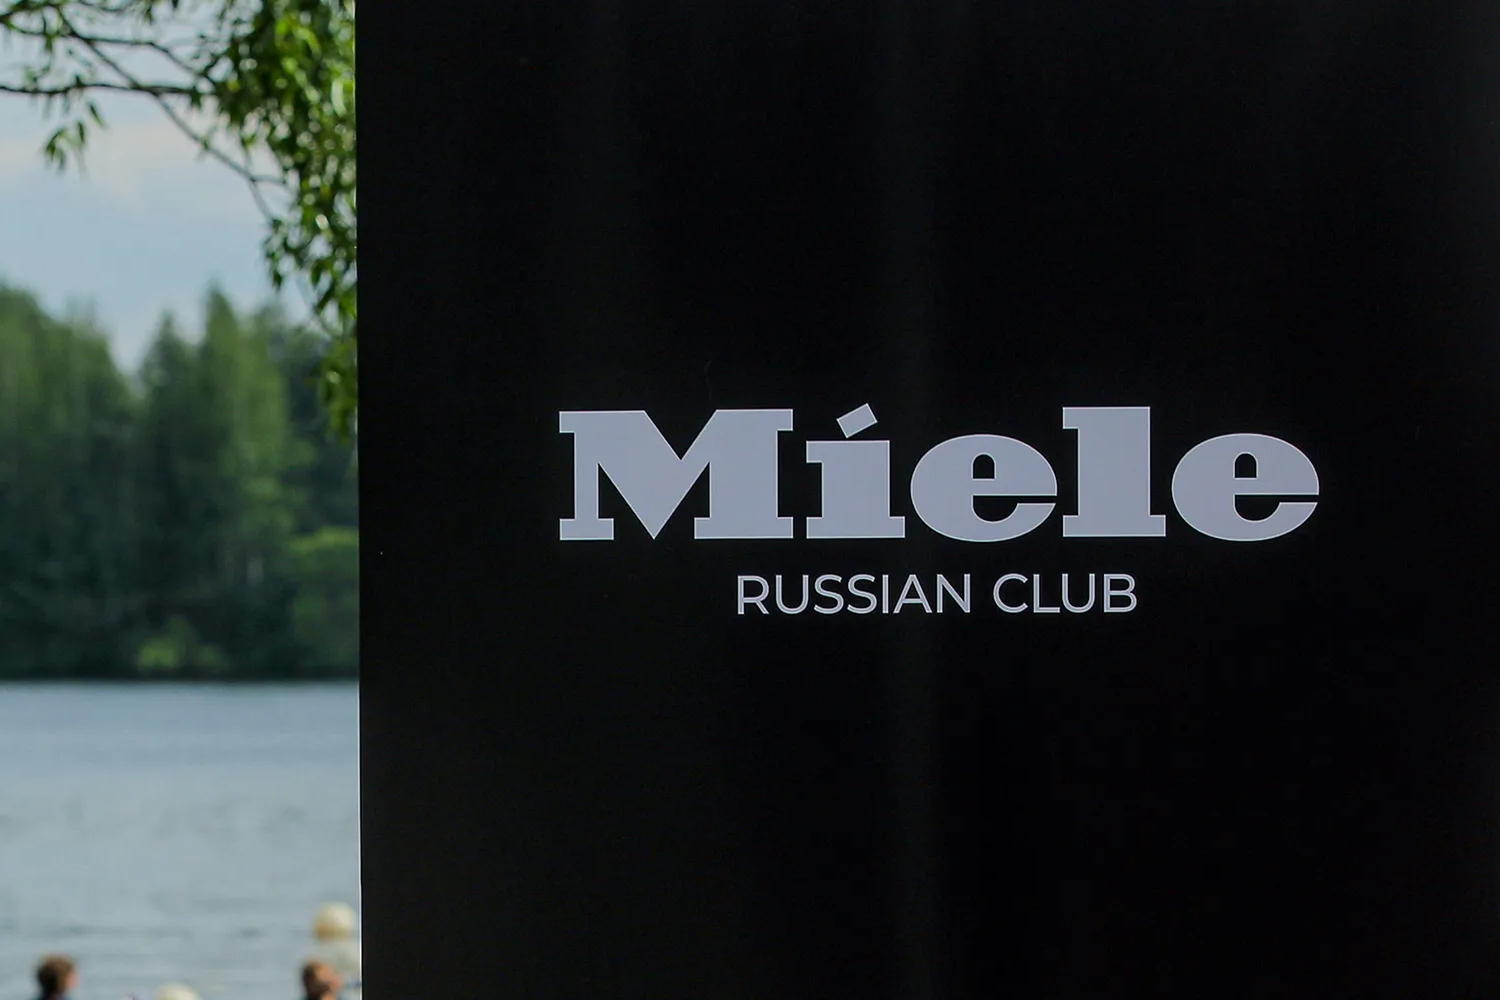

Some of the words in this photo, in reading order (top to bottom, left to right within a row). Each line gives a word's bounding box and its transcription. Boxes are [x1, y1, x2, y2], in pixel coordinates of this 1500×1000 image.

[558, 402, 1320, 542] Miele
[737, 573, 971, 615] RUSSIAN
[992, 573, 1138, 614] CLUB
